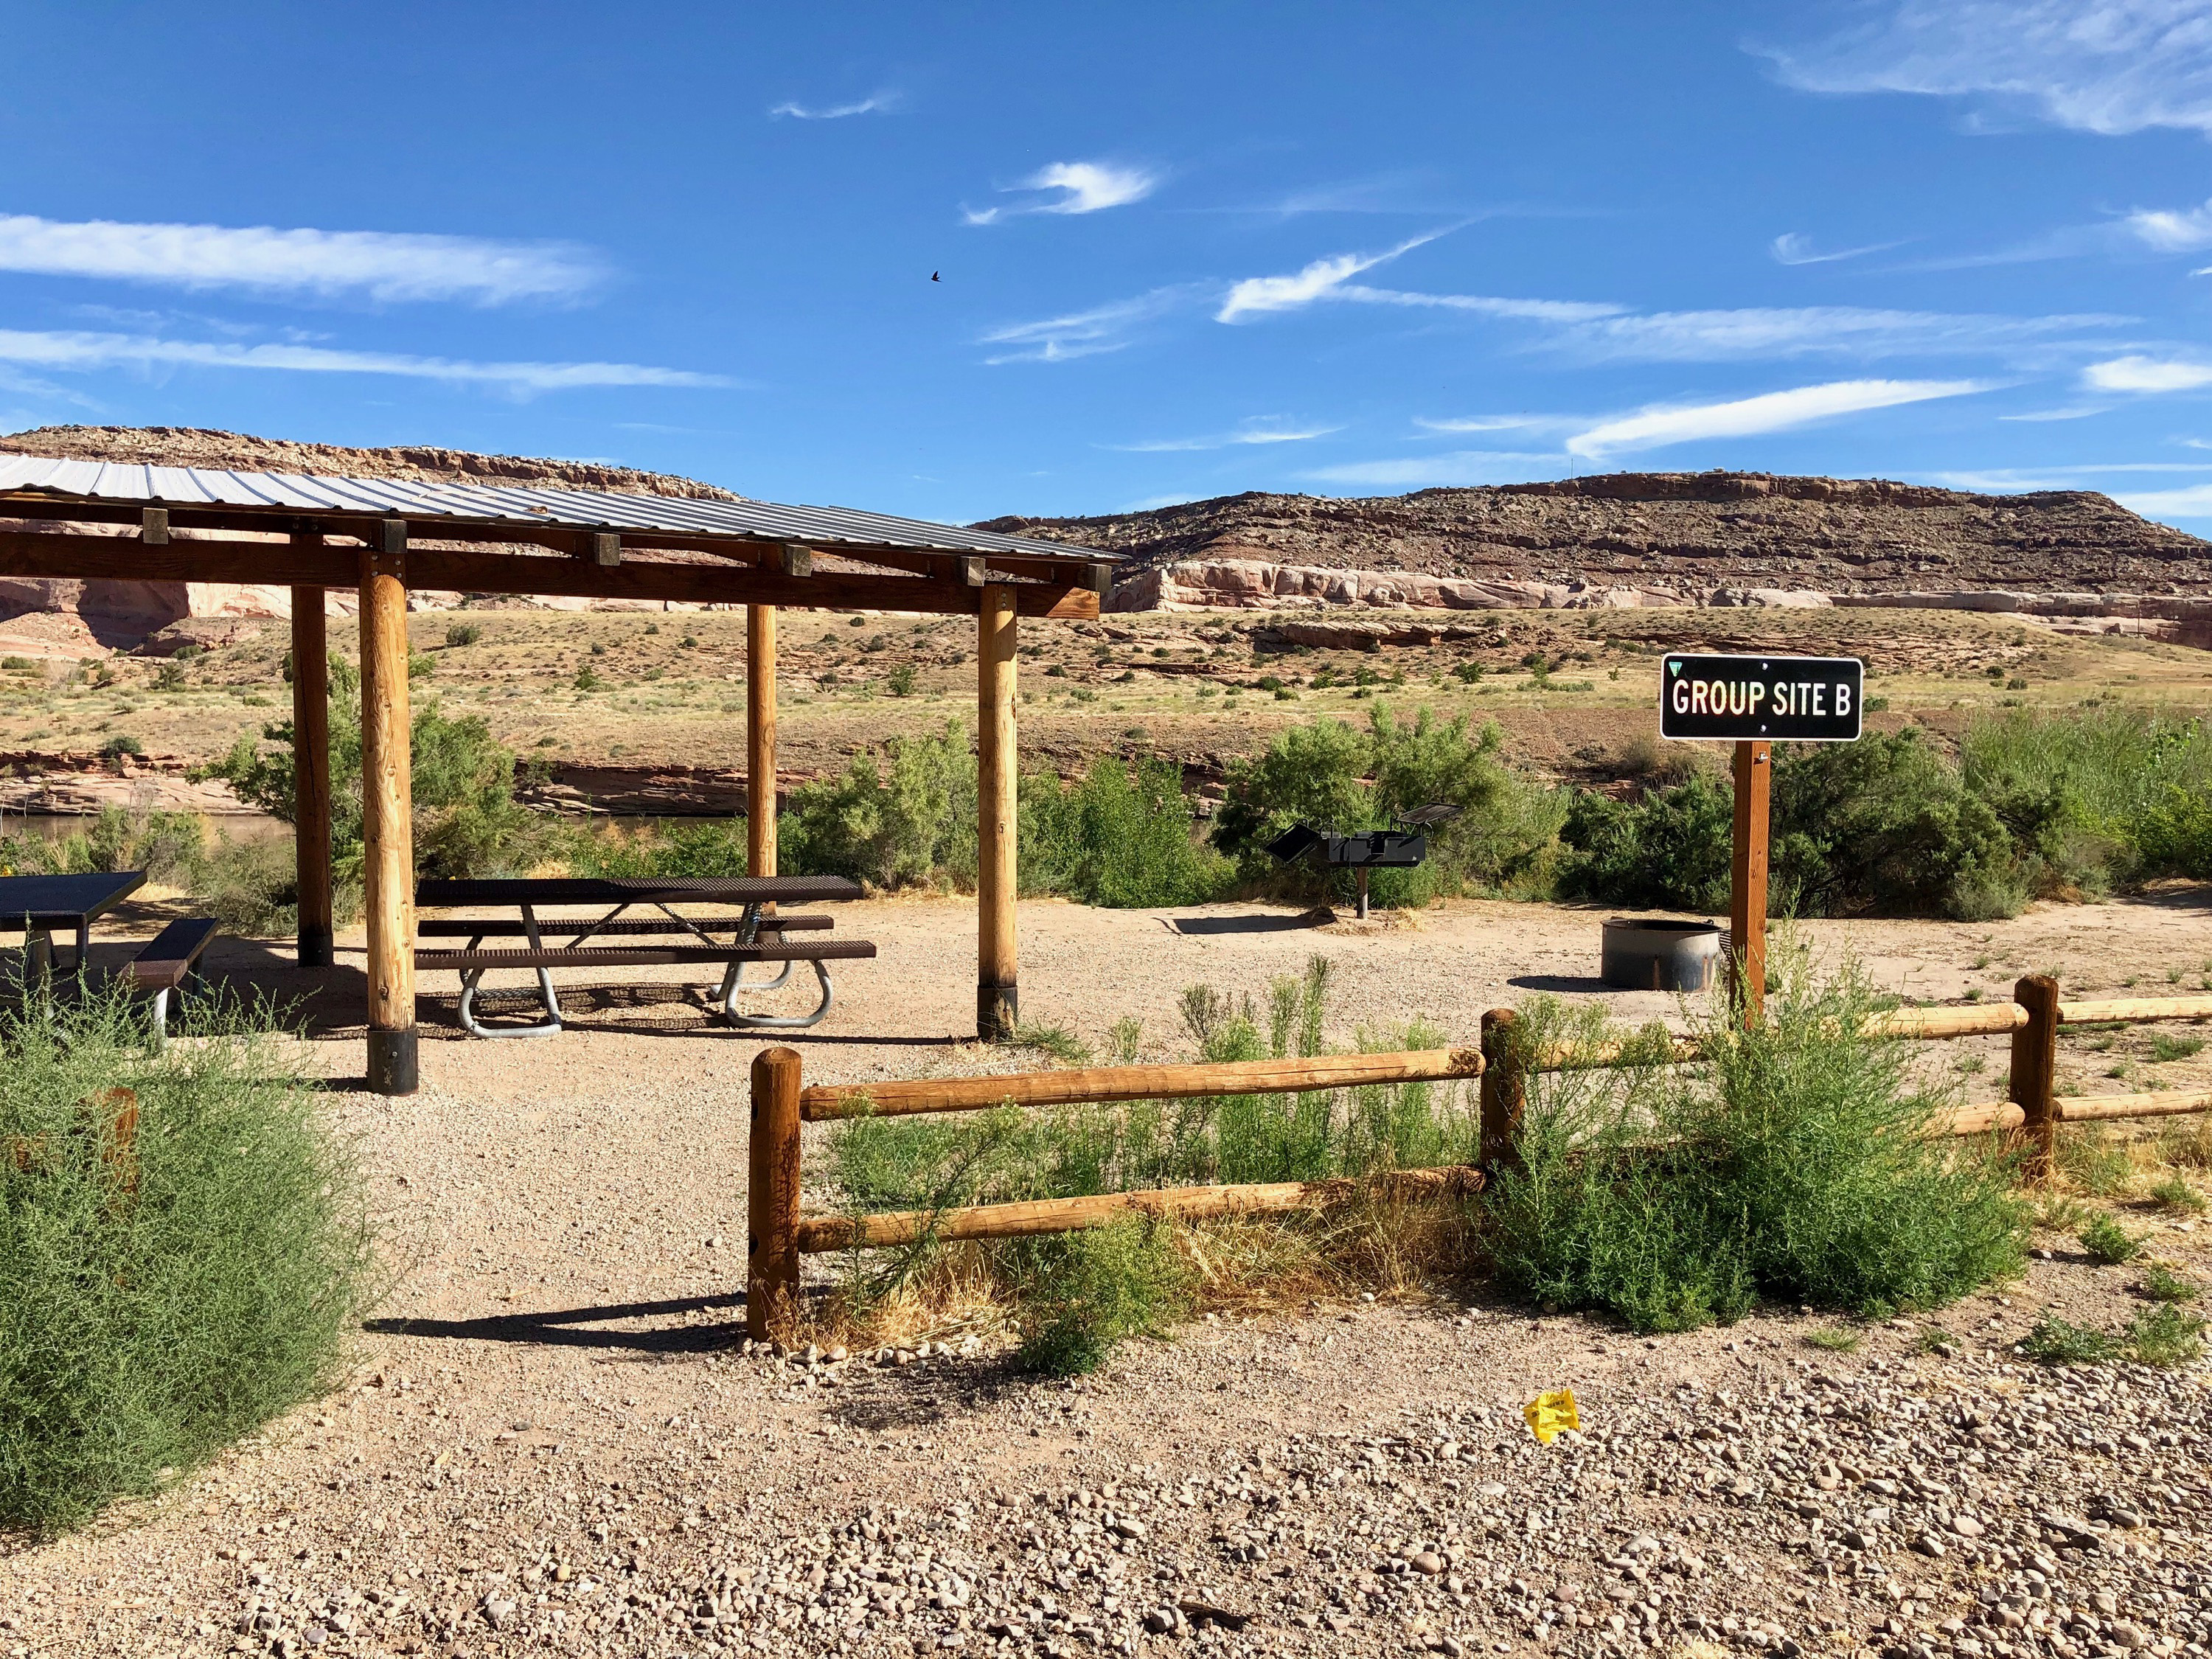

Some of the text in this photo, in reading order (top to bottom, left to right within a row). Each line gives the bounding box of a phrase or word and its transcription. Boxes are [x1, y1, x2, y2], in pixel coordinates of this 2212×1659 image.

[1672, 679, 1851, 716] GROUP SITE B
